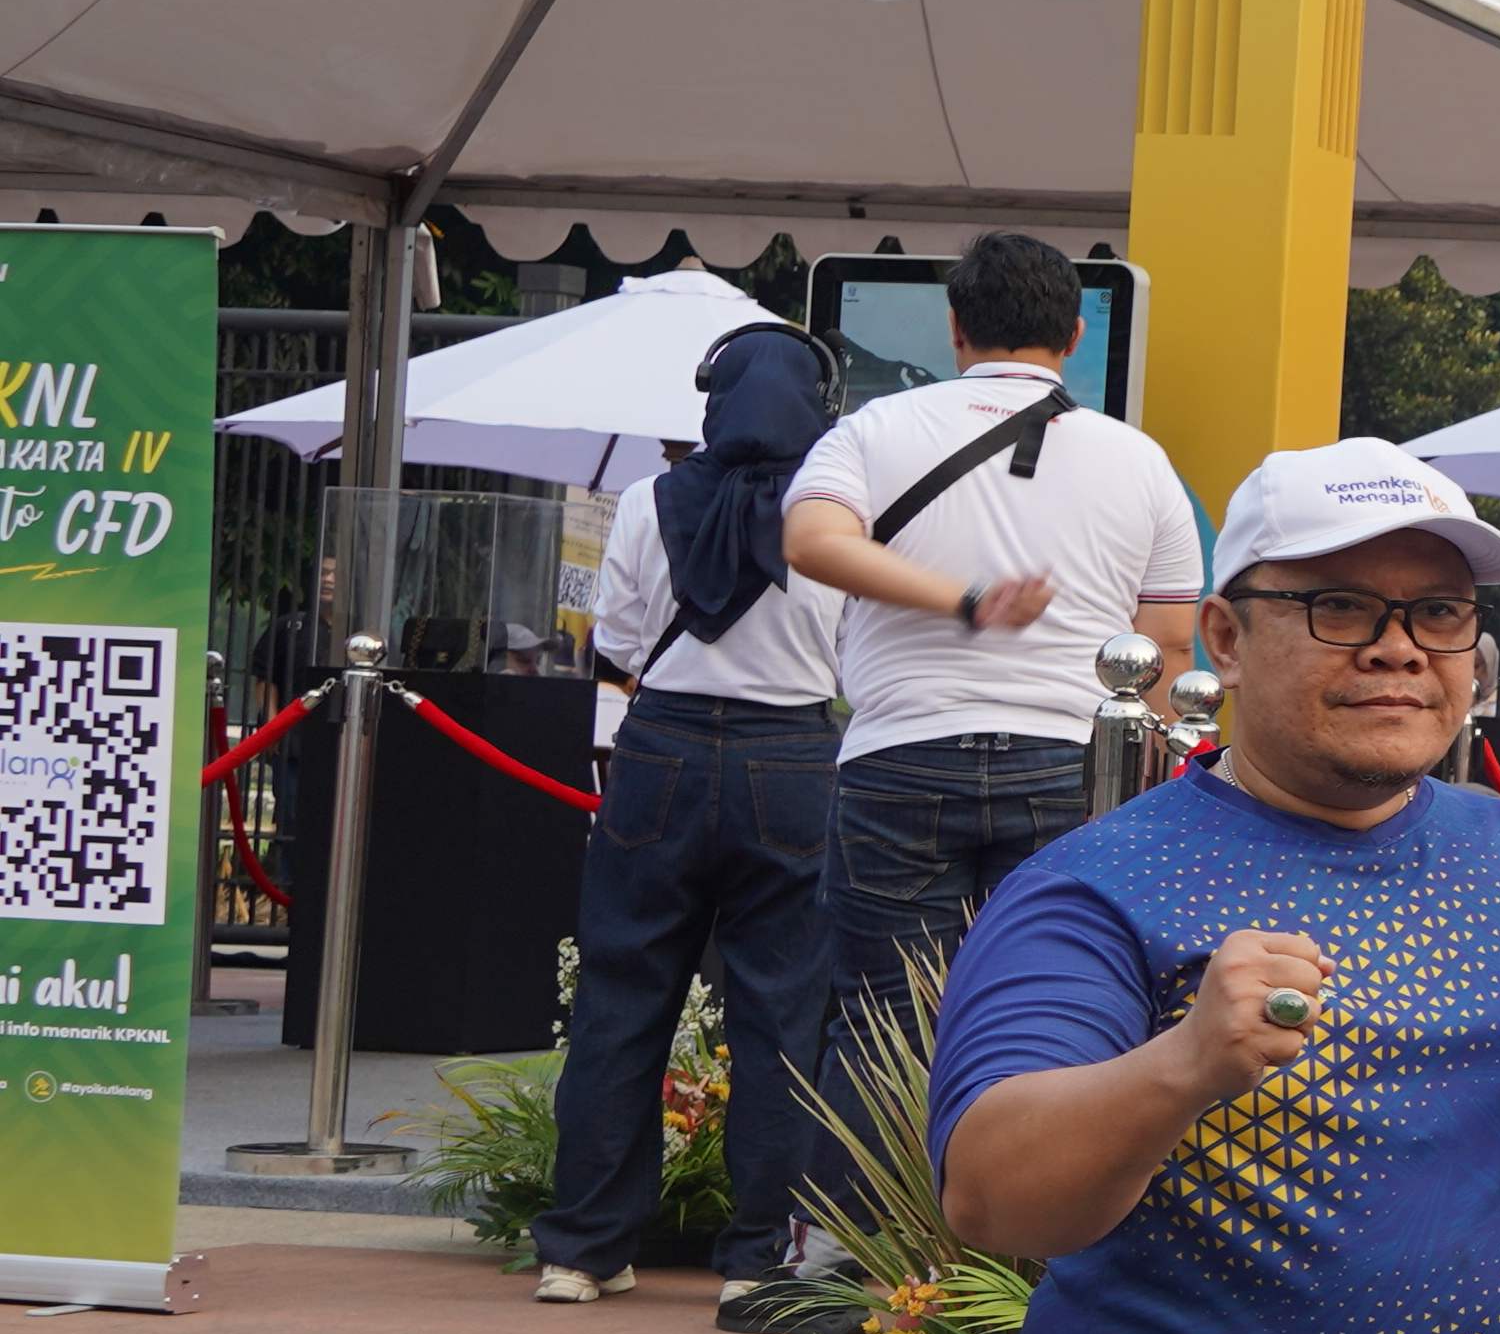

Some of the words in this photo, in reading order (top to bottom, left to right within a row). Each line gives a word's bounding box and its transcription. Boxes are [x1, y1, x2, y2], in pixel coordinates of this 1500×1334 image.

[122, 430, 172, 474] IV
[1324, 475, 1422, 495] Kemenkeu
[1338, 490, 1424, 506] Mengajar
[56, 489, 174, 558] CFD
[35, 953, 131, 1014] aku!
[8, 1021, 40, 1037] info
[42, 1025, 112, 1041] menarik
[114, 1028, 171, 1044] KPKNL
